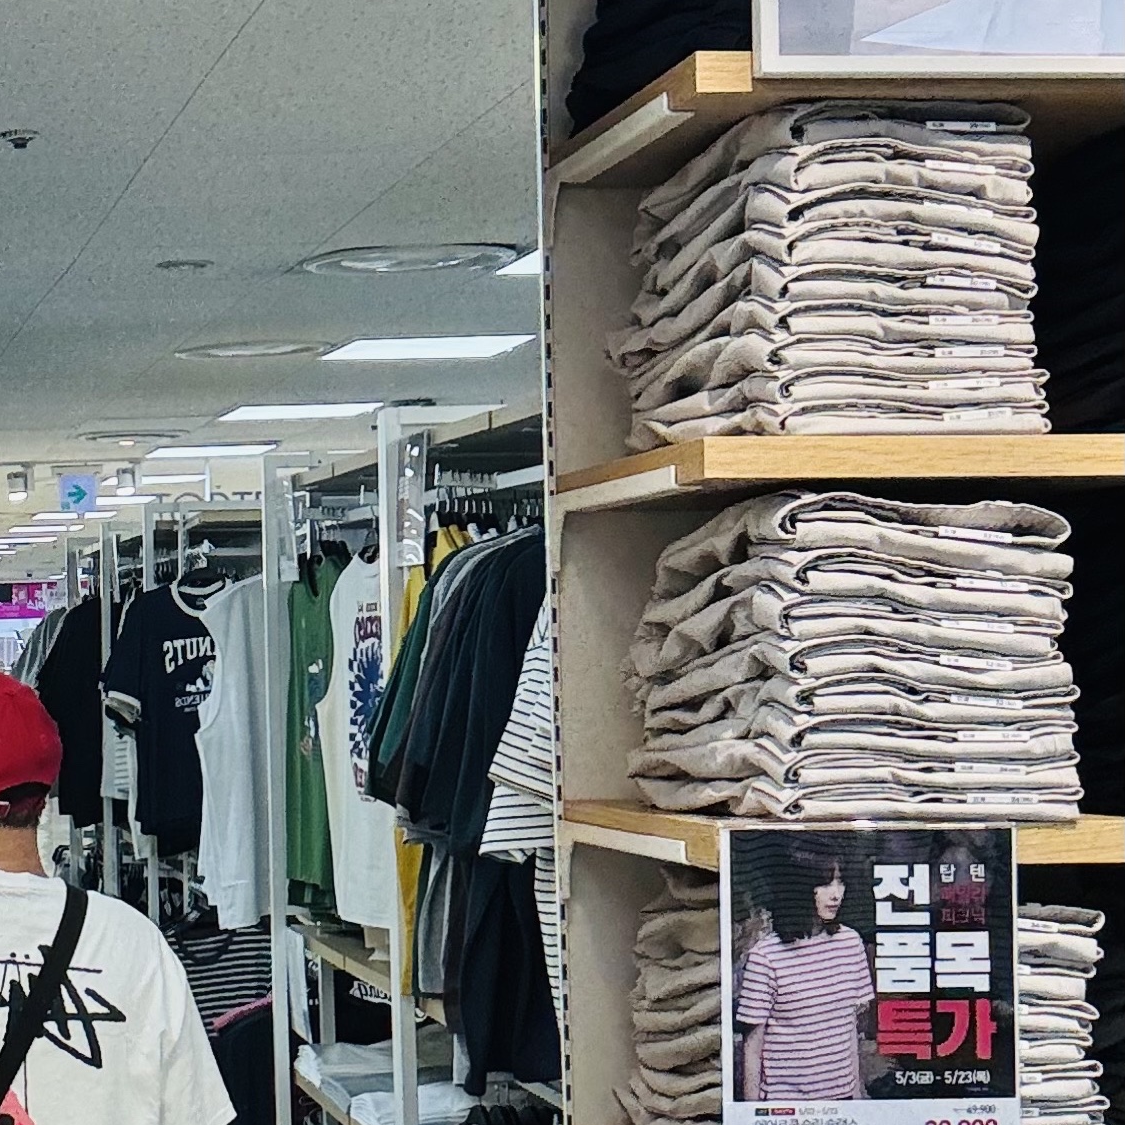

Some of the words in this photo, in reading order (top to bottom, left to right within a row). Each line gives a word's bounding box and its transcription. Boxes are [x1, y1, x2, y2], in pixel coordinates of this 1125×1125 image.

[873, 864, 930, 925] 전
[875, 931, 991, 992] 품목
[877, 998, 998, 1060] 특가
